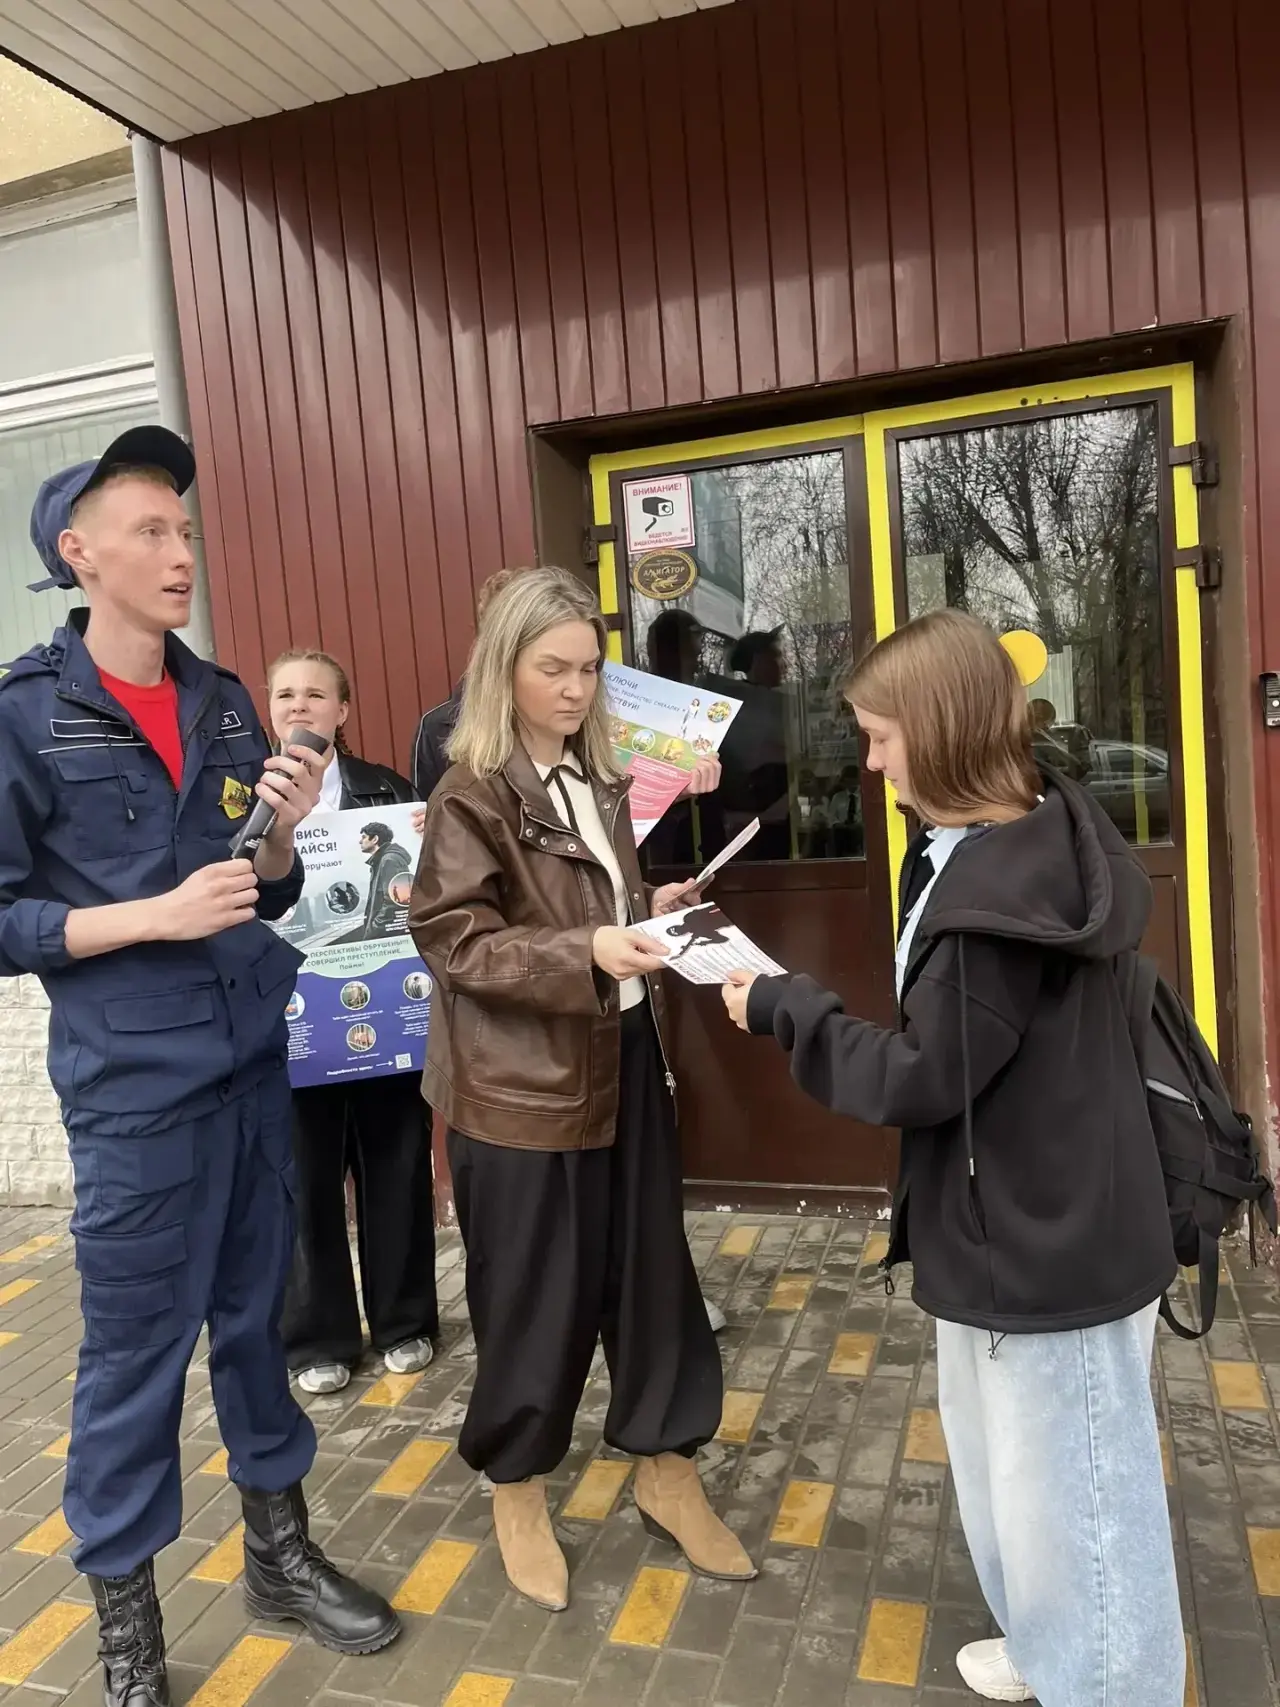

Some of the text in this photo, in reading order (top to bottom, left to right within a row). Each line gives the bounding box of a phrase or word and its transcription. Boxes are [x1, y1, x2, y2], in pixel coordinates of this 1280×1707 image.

[633, 483, 681, 496] ВНИМАНИЕ!
[296, 828, 329, 840] ВИСЬ
[300, 842, 337, 855] АЙСЯ!
[304, 860, 342, 871] оручают
[310, 946, 362, 958] ПЕРСПЕКТИВЫ
[305, 957, 346, 968] СОВЕРШИЛ
